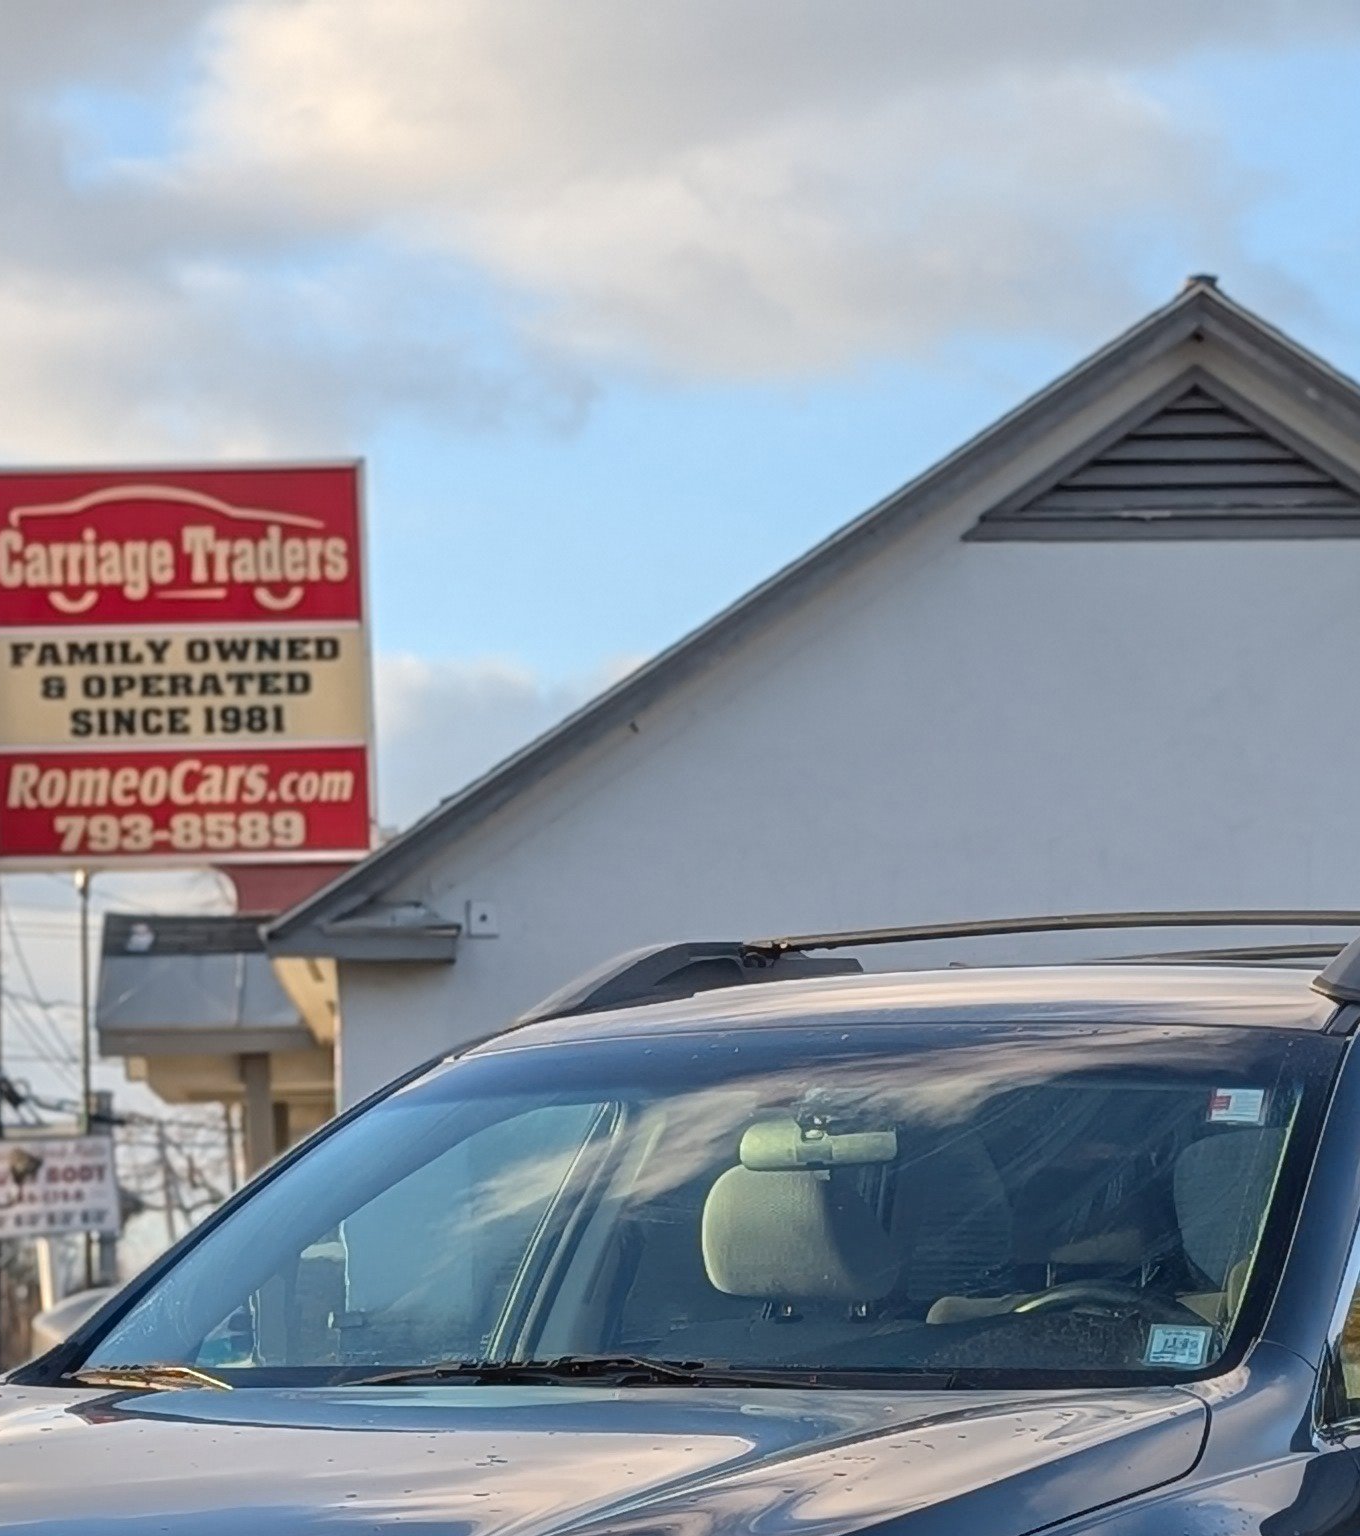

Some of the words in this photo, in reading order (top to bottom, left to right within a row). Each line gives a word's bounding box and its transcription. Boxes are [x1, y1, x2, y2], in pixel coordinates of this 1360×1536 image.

[181, 524, 349, 583] Traders
[9, 640, 171, 668] FAMILY
[185, 636, 341, 662] OWNED
[41, 675, 67, 699] &
[82, 671, 312, 698] OPERATED
[70, 708, 191, 737] SINCE
[204, 705, 285, 733] 1981
[7, 759, 354, 808] RomeoCars.com
[54, 811, 306, 852] 793-8589
